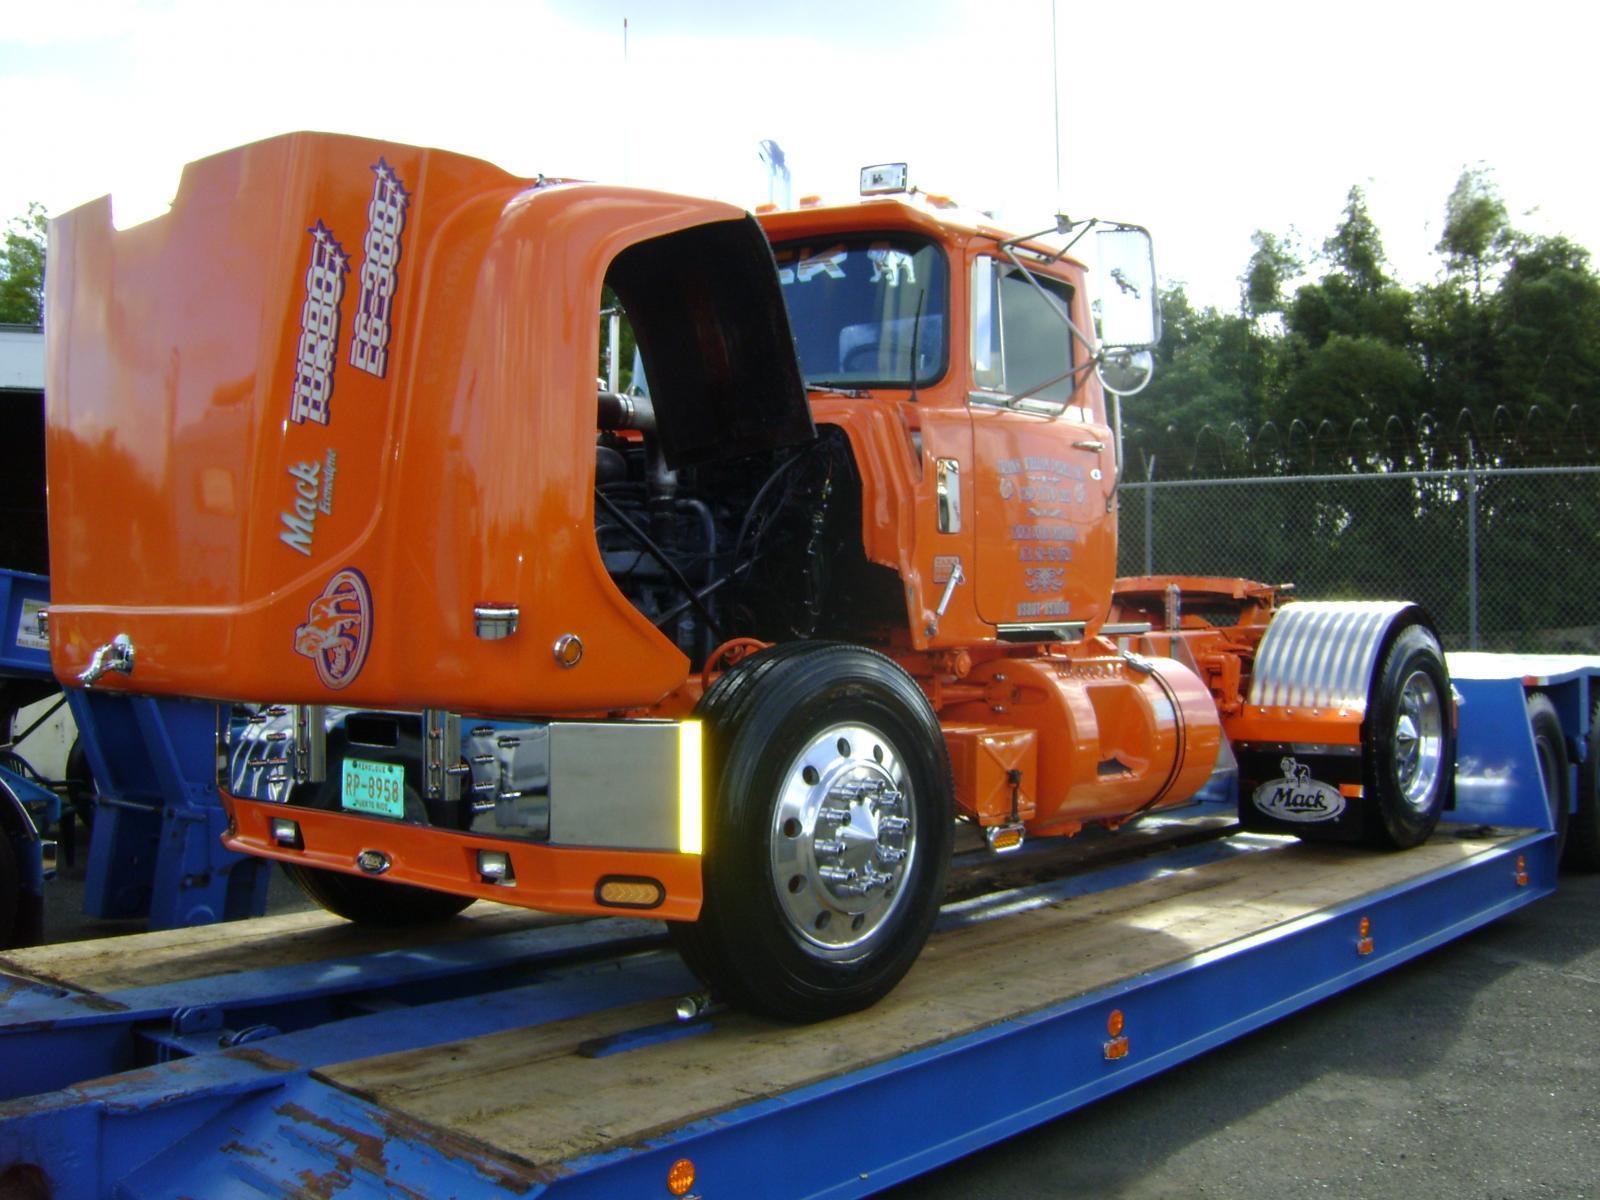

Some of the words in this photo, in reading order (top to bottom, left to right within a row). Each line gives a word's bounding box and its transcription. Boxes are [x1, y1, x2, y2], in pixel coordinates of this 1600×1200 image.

[290, 264, 345, 426] TURBO
[279, 460, 321, 557] Mack
[345, 773, 399, 803] RP-8958
[1270, 787, 1327, 811] Mack
